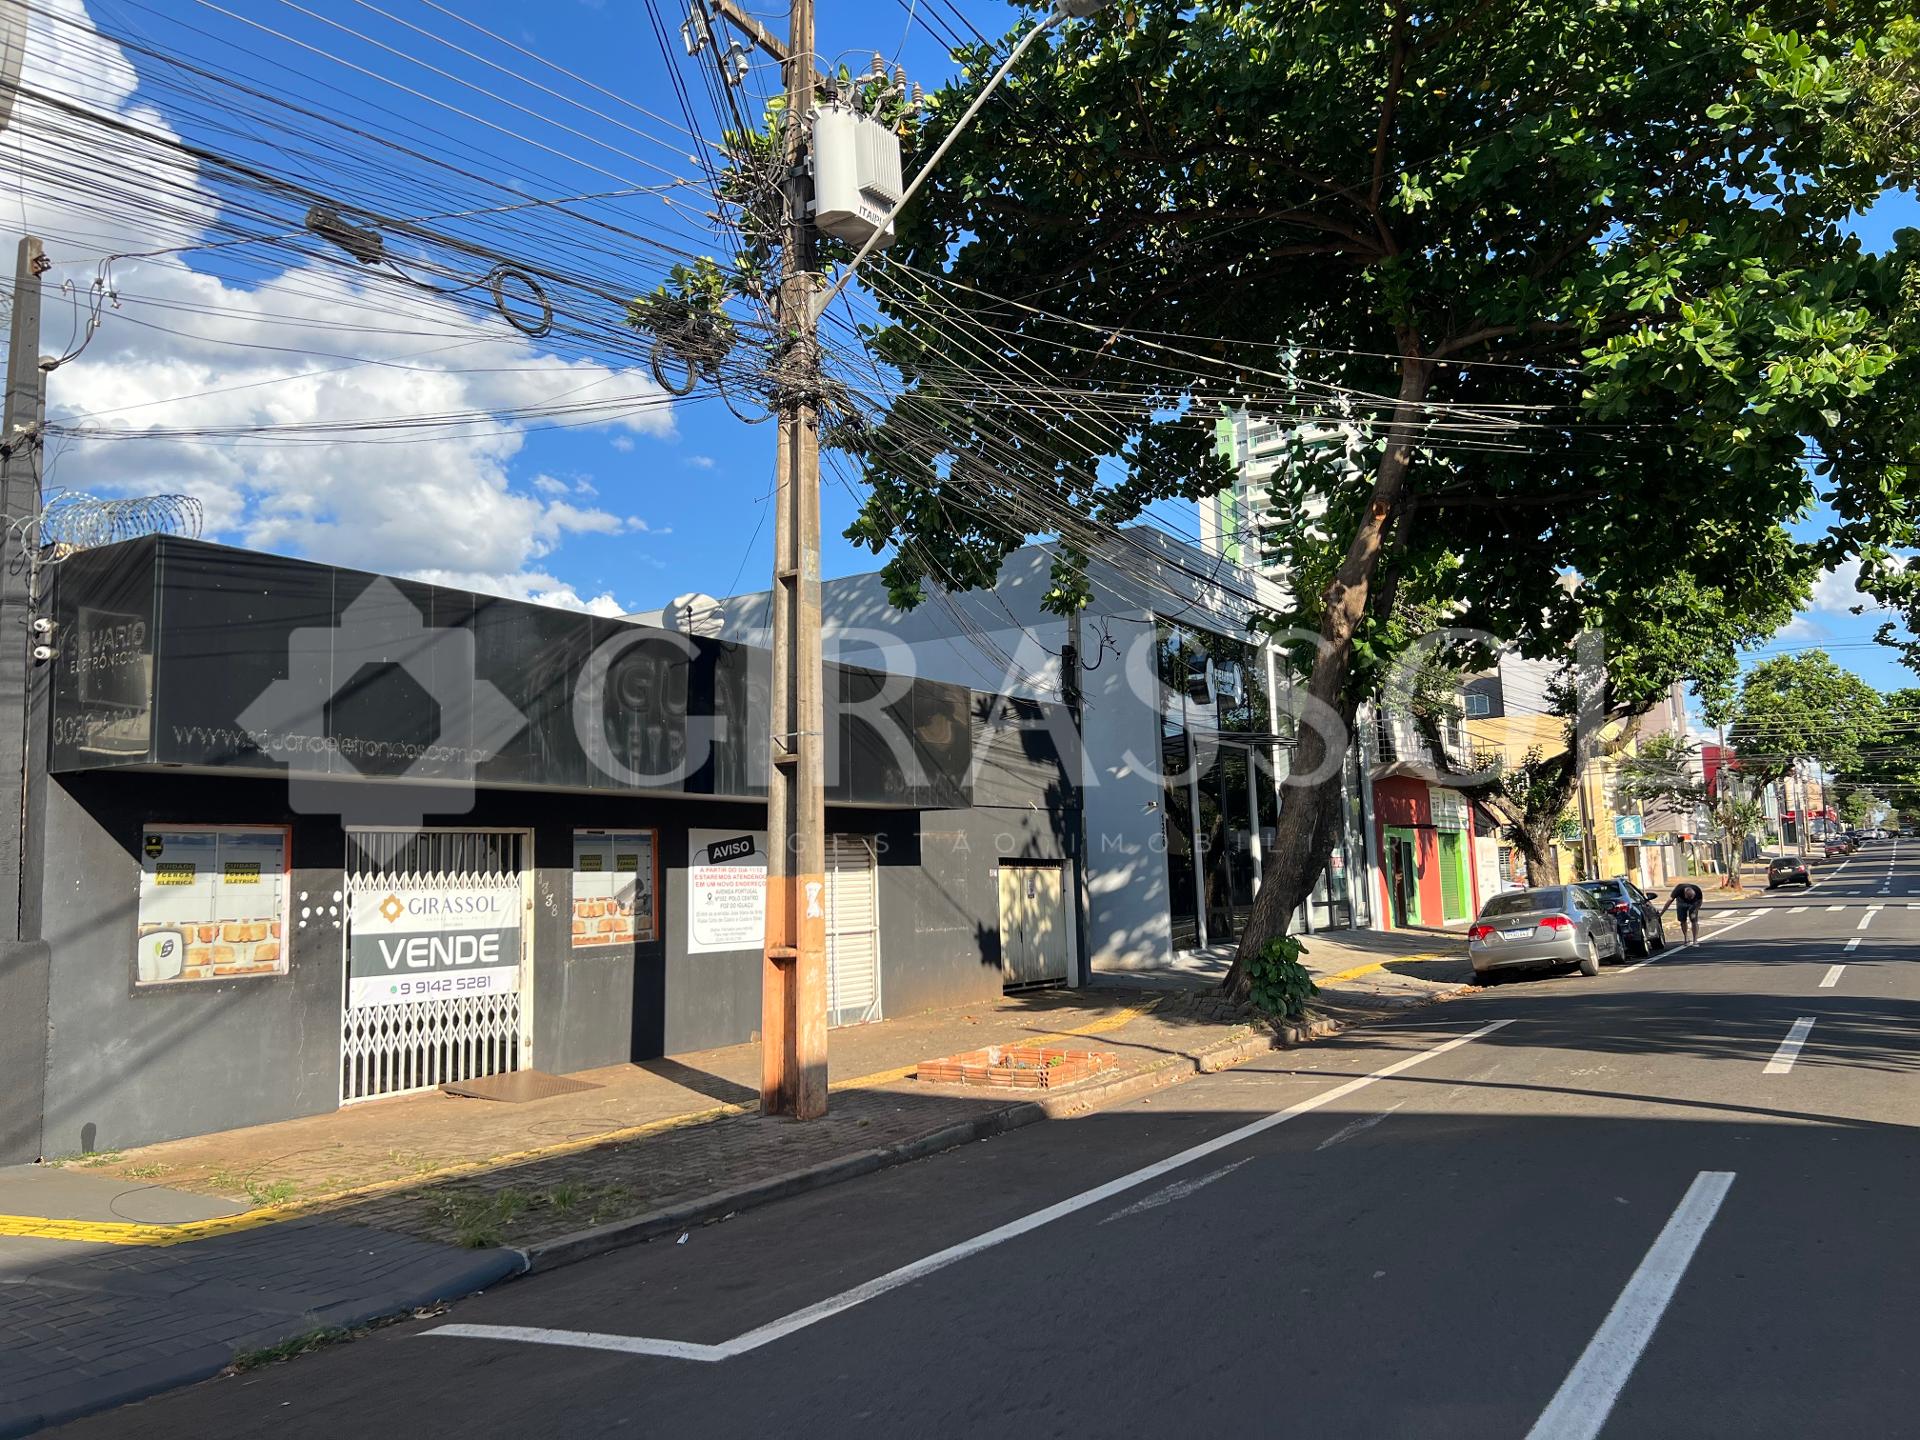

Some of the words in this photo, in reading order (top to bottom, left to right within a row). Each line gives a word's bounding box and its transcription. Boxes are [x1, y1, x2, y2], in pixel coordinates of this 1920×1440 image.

[712, 840, 750, 859] AVISO
[408, 896, 501, 915] GIRASSOL
[378, 933, 500, 970] VENDE
[400, 983, 411, 995] 9
[415, 979, 452, 994] 9142
[456, 976, 491, 990] 5281
